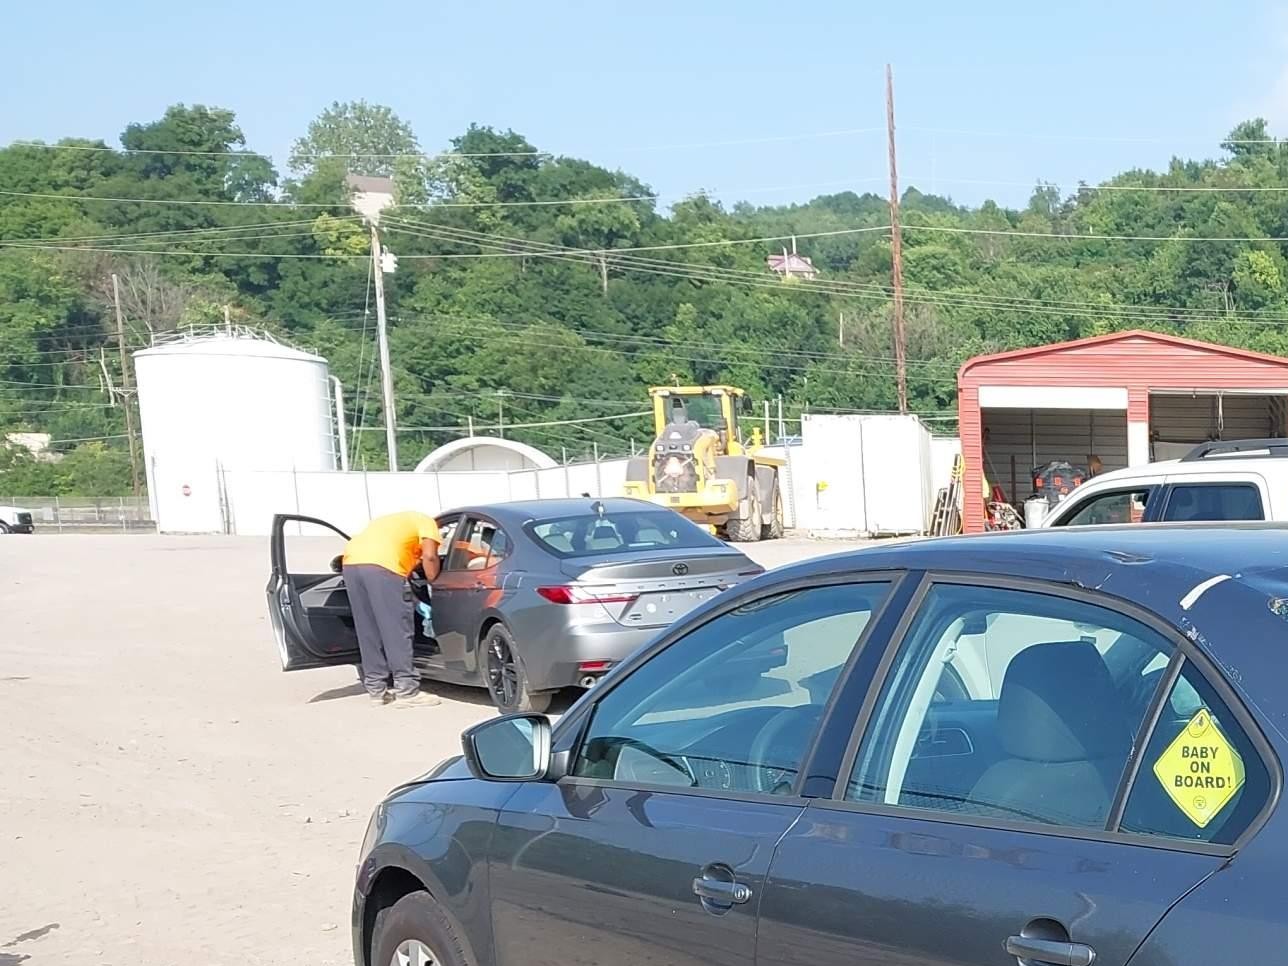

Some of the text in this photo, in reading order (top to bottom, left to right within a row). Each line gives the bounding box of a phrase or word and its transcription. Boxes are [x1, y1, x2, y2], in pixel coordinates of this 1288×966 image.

[1181, 746, 1219, 759] BABY
[1189, 761, 1210, 774] ON
[1174, 775, 1232, 789] BOARD!
